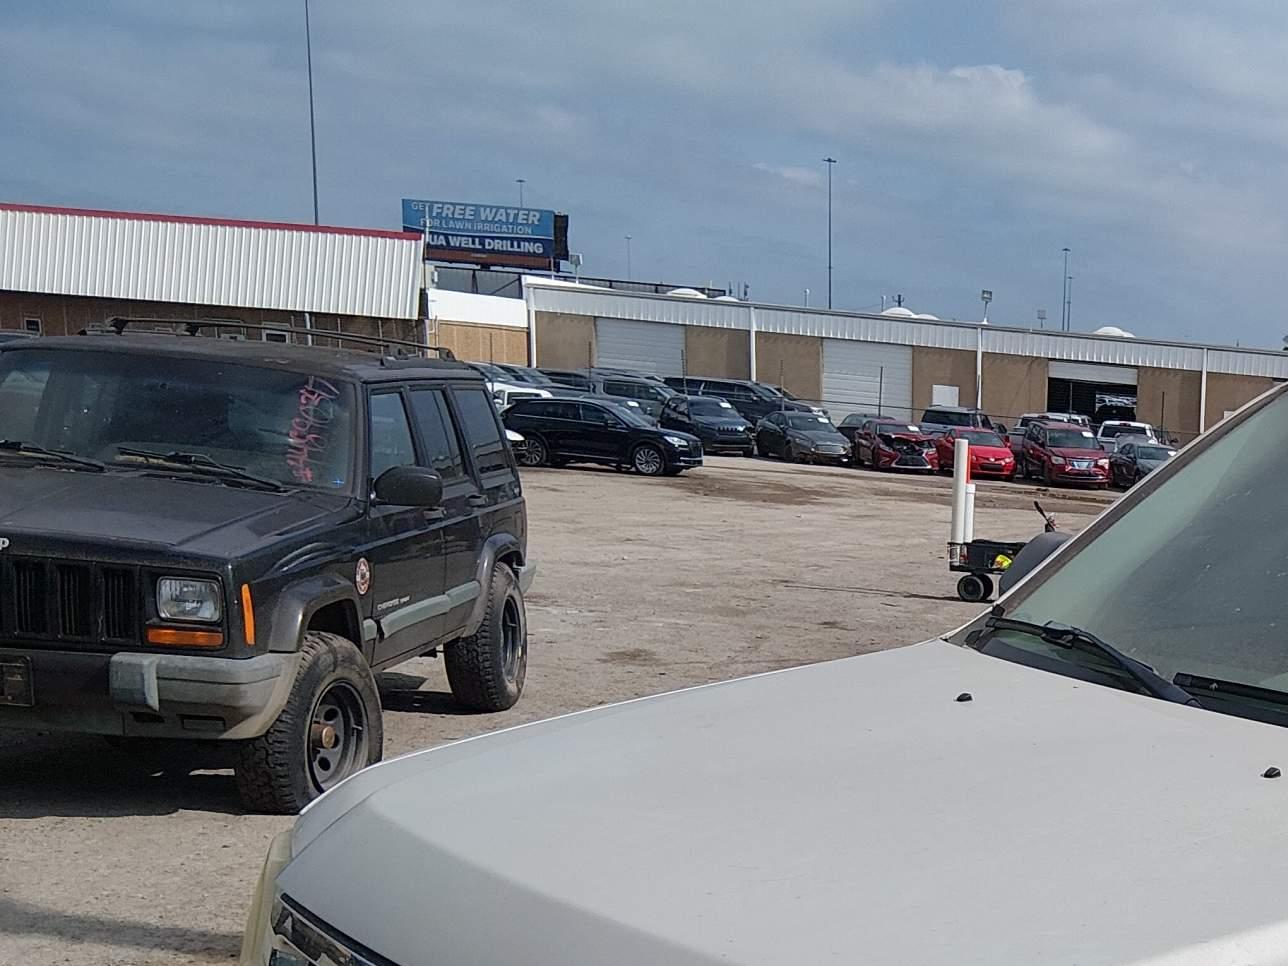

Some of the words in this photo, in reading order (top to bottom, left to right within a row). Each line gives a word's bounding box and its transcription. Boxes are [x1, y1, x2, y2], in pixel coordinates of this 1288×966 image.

[432, 203, 476, 219] FREE
[480, 207, 541, 225] WATER
[442, 219, 472, 231] LAWN
[473, 222, 532, 235] IRRIGATION
[429, 233, 447, 247] UA
[448, 236, 482, 249] WELL
[484, 240, 544, 254] DRILLING
